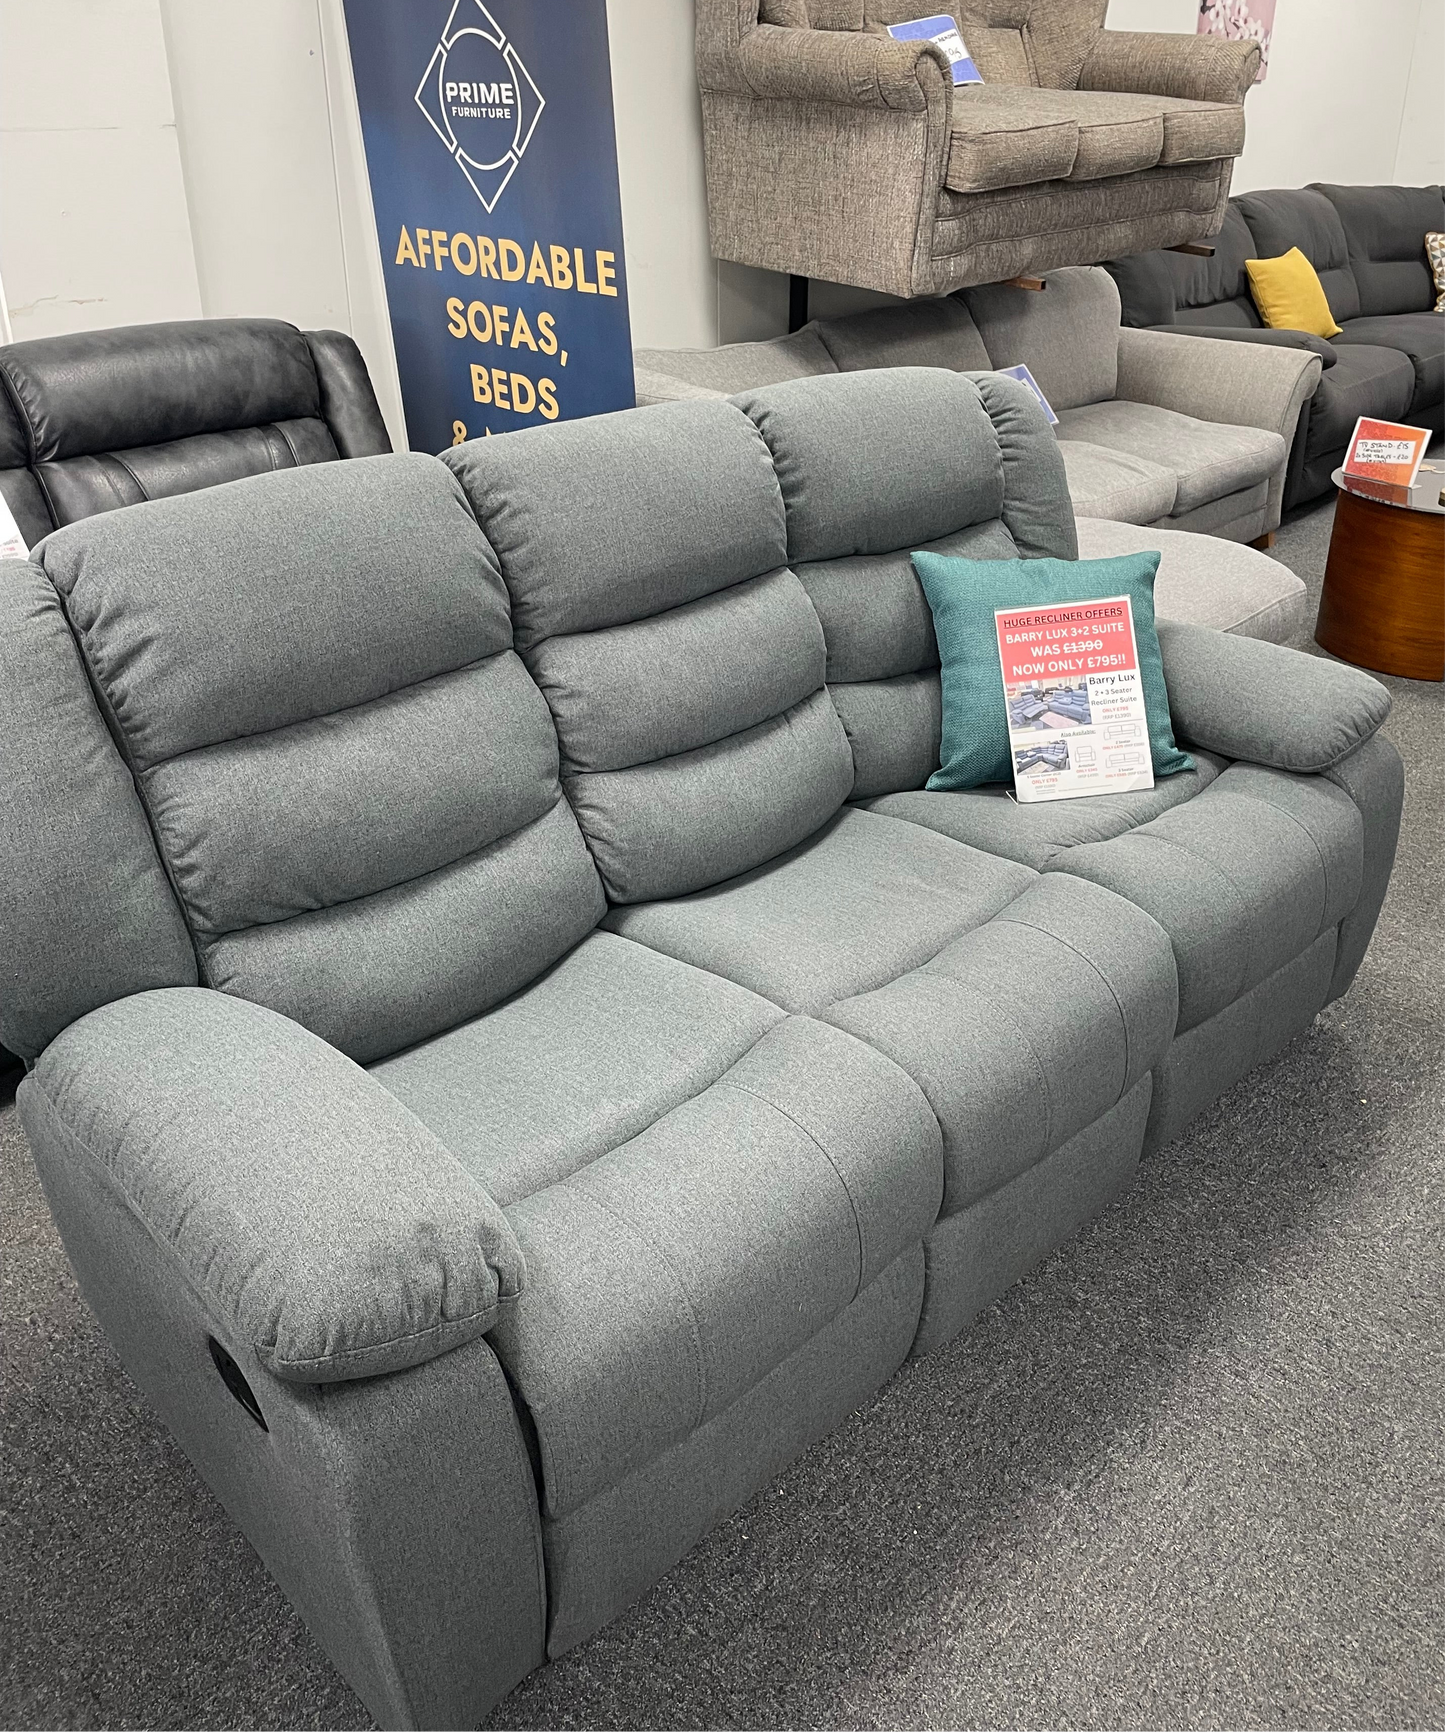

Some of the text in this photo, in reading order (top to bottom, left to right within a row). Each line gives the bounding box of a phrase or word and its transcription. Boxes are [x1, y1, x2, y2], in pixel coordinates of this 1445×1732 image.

[445, 82, 515, 105] PRIME
[451, 106, 512, 119] FURNITURE
[395, 224, 618, 297] AFFORDABLE
[446, 297, 569, 367] SOFAS,
[470, 363, 560, 420] BEDS
[1003, 607, 1123, 628] HUGE RECLINER OFFERS
[1006, 622, 1124, 644] BARRY LUX 3+2 SUITE
[1030, 640, 1104, 658] WAS £1390
[1012, 654, 1126, 676] NOW ONLY £795!!
[1088, 676, 1116, 686] Barry
[1091, 698, 1118, 706] Recliner
